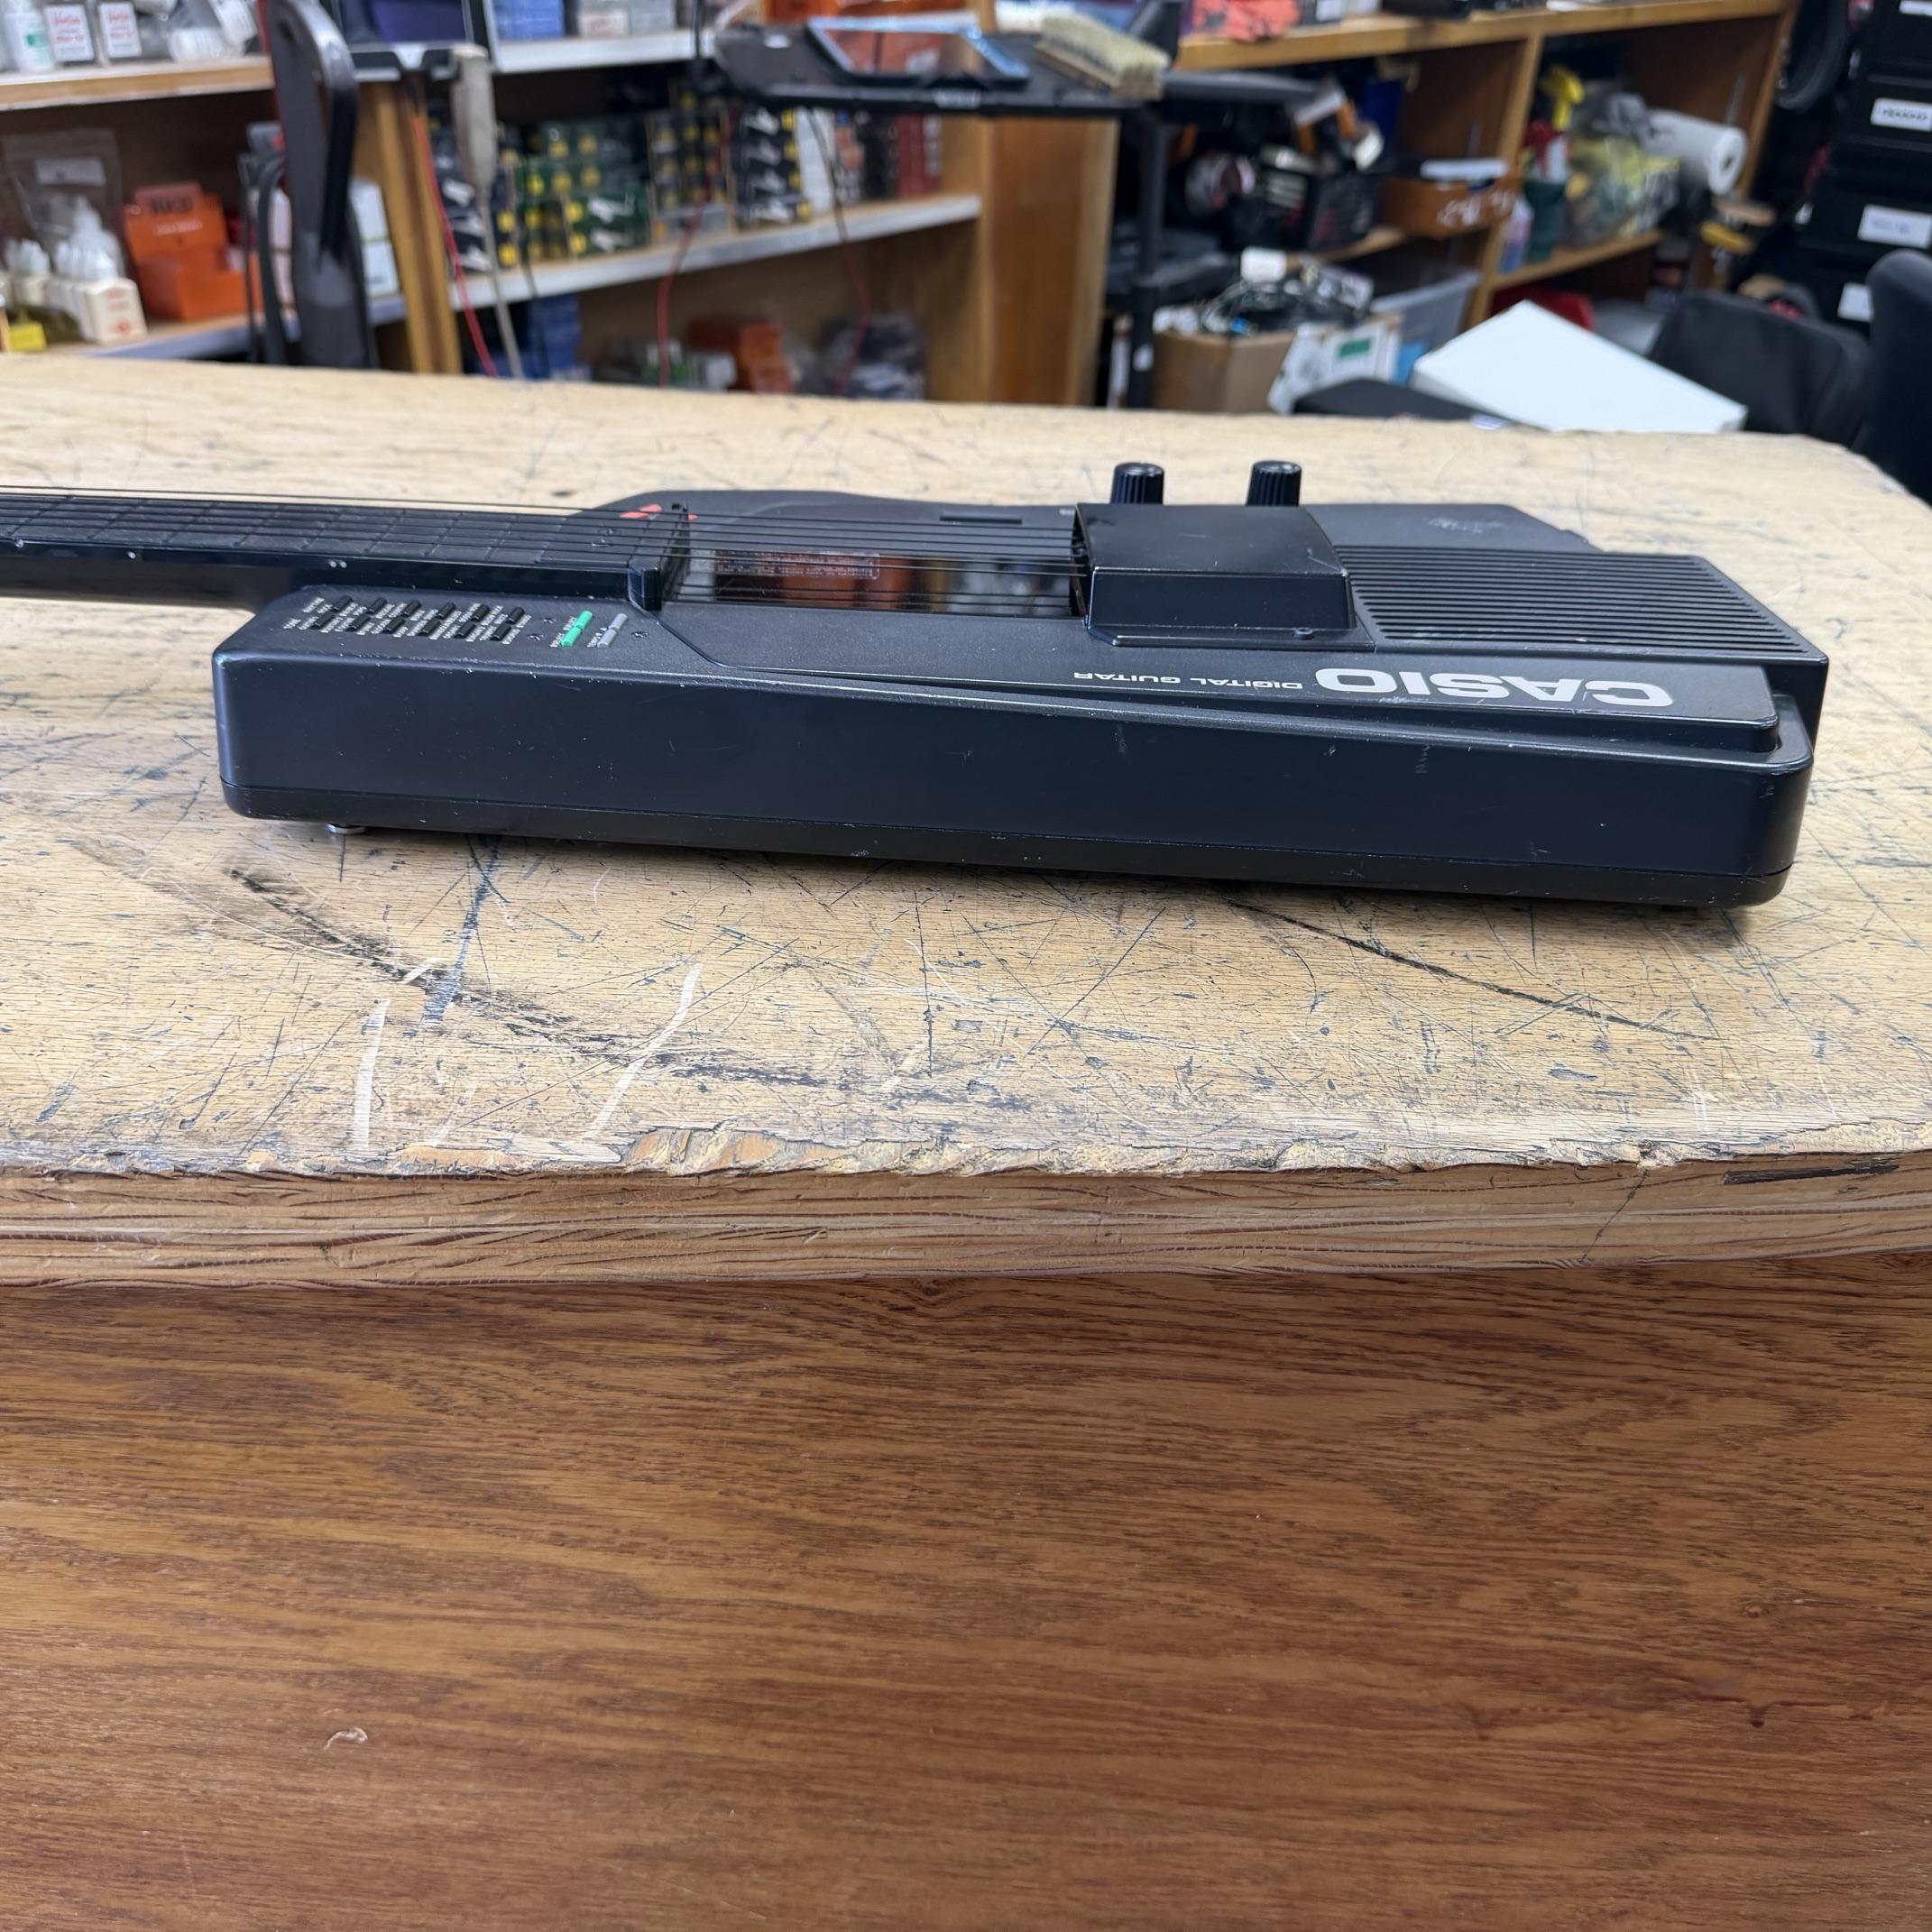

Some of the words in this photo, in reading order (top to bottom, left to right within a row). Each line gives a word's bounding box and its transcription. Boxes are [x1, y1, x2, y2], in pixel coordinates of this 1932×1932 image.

[1073, 672, 1182, 684] GUITAR
[1190, 677, 1303, 689] DIGITAL
[1314, 667, 1674, 707] CASIO
